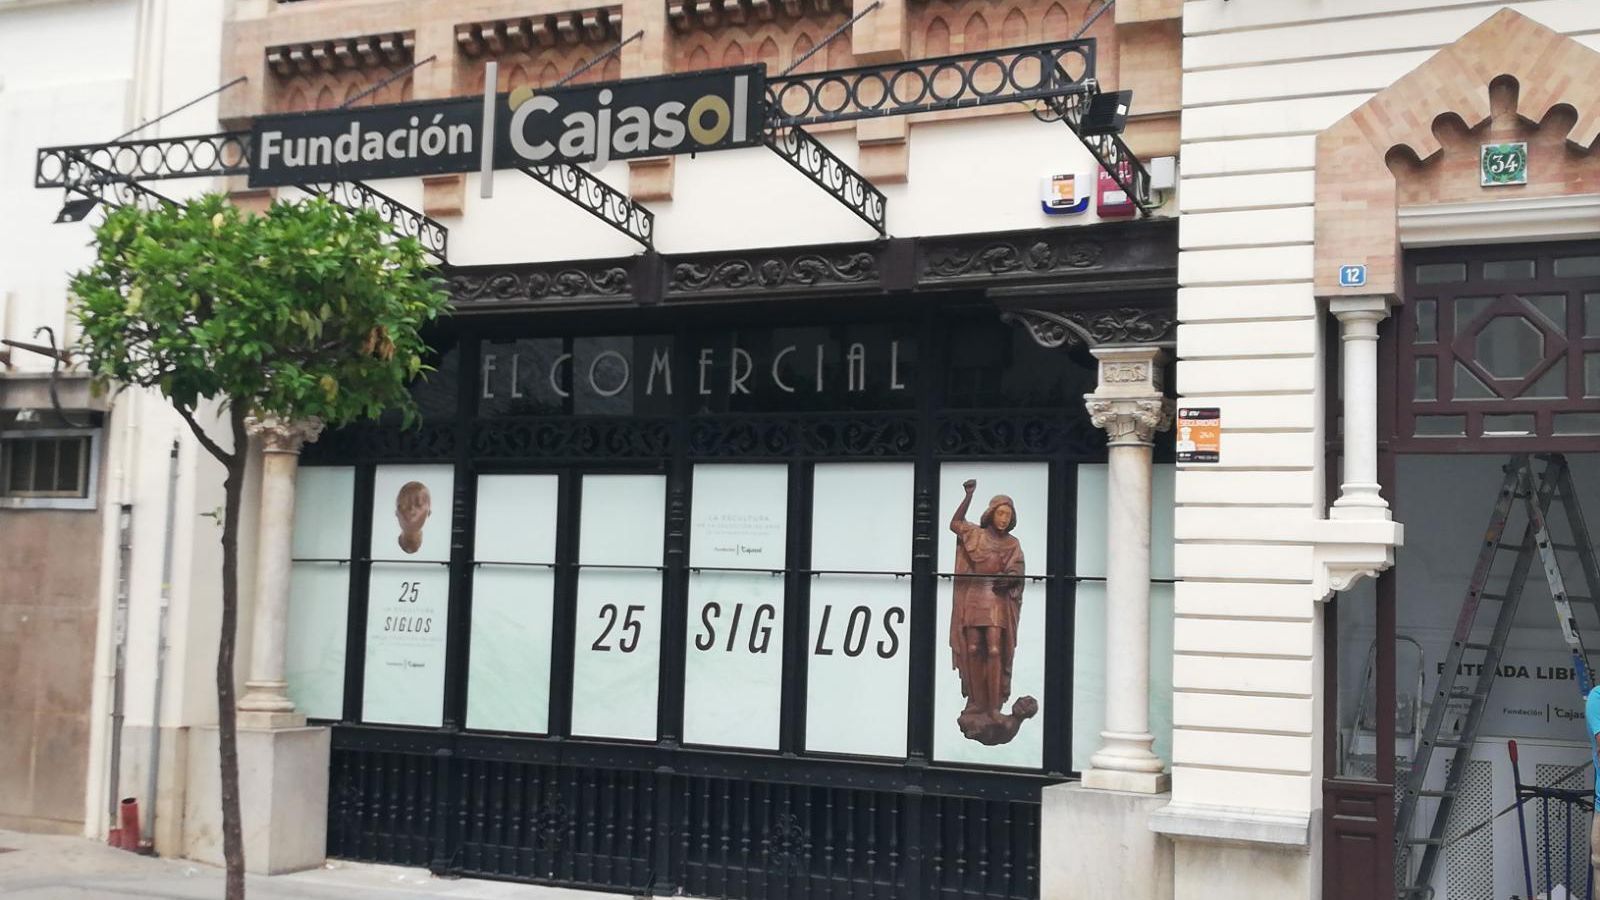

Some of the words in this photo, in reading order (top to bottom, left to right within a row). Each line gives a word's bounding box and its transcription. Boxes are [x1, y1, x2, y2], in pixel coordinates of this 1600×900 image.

[260, 113, 473, 170] Fundación
[509, 74, 749, 172] Cajasol
[1491, 153, 1518, 173] 34
[1345, 267, 1360, 283] 12
[483, 354, 523, 399] EL
[398, 581, 421, 603] 25
[384, 616, 432, 633] SIGLOS
[591, 603, 645, 653] 25
